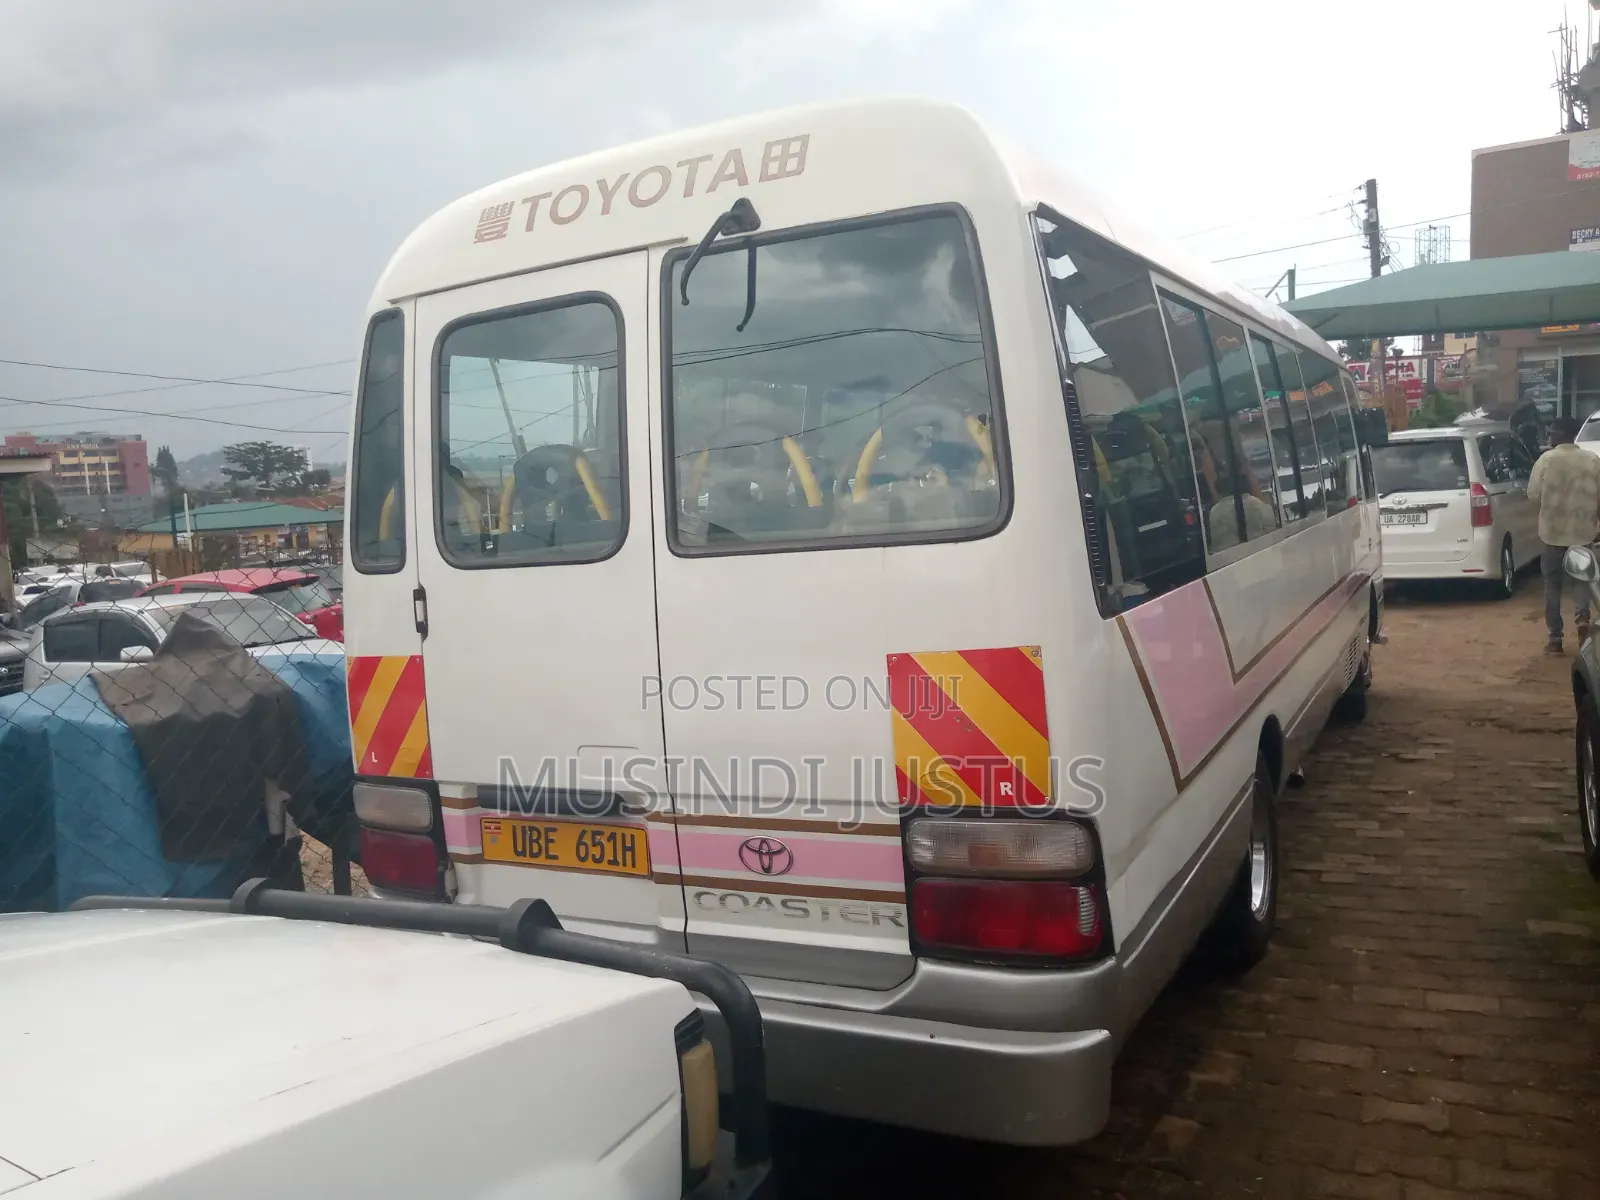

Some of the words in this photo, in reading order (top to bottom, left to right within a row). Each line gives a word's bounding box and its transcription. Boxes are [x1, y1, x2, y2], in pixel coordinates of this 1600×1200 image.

[759, 134, 810, 183] 田
[521, 148, 749, 232] TOYOTA
[1367, 361, 1415, 375] PHA
[1398, 514, 1420, 523] 278AR
[371, 751, 378, 763] L
[1000, 781, 1014, 796] R
[512, 824, 560, 861] UBE
[575, 828, 637, 868] 651H
[693, 891, 905, 928] COASTER
